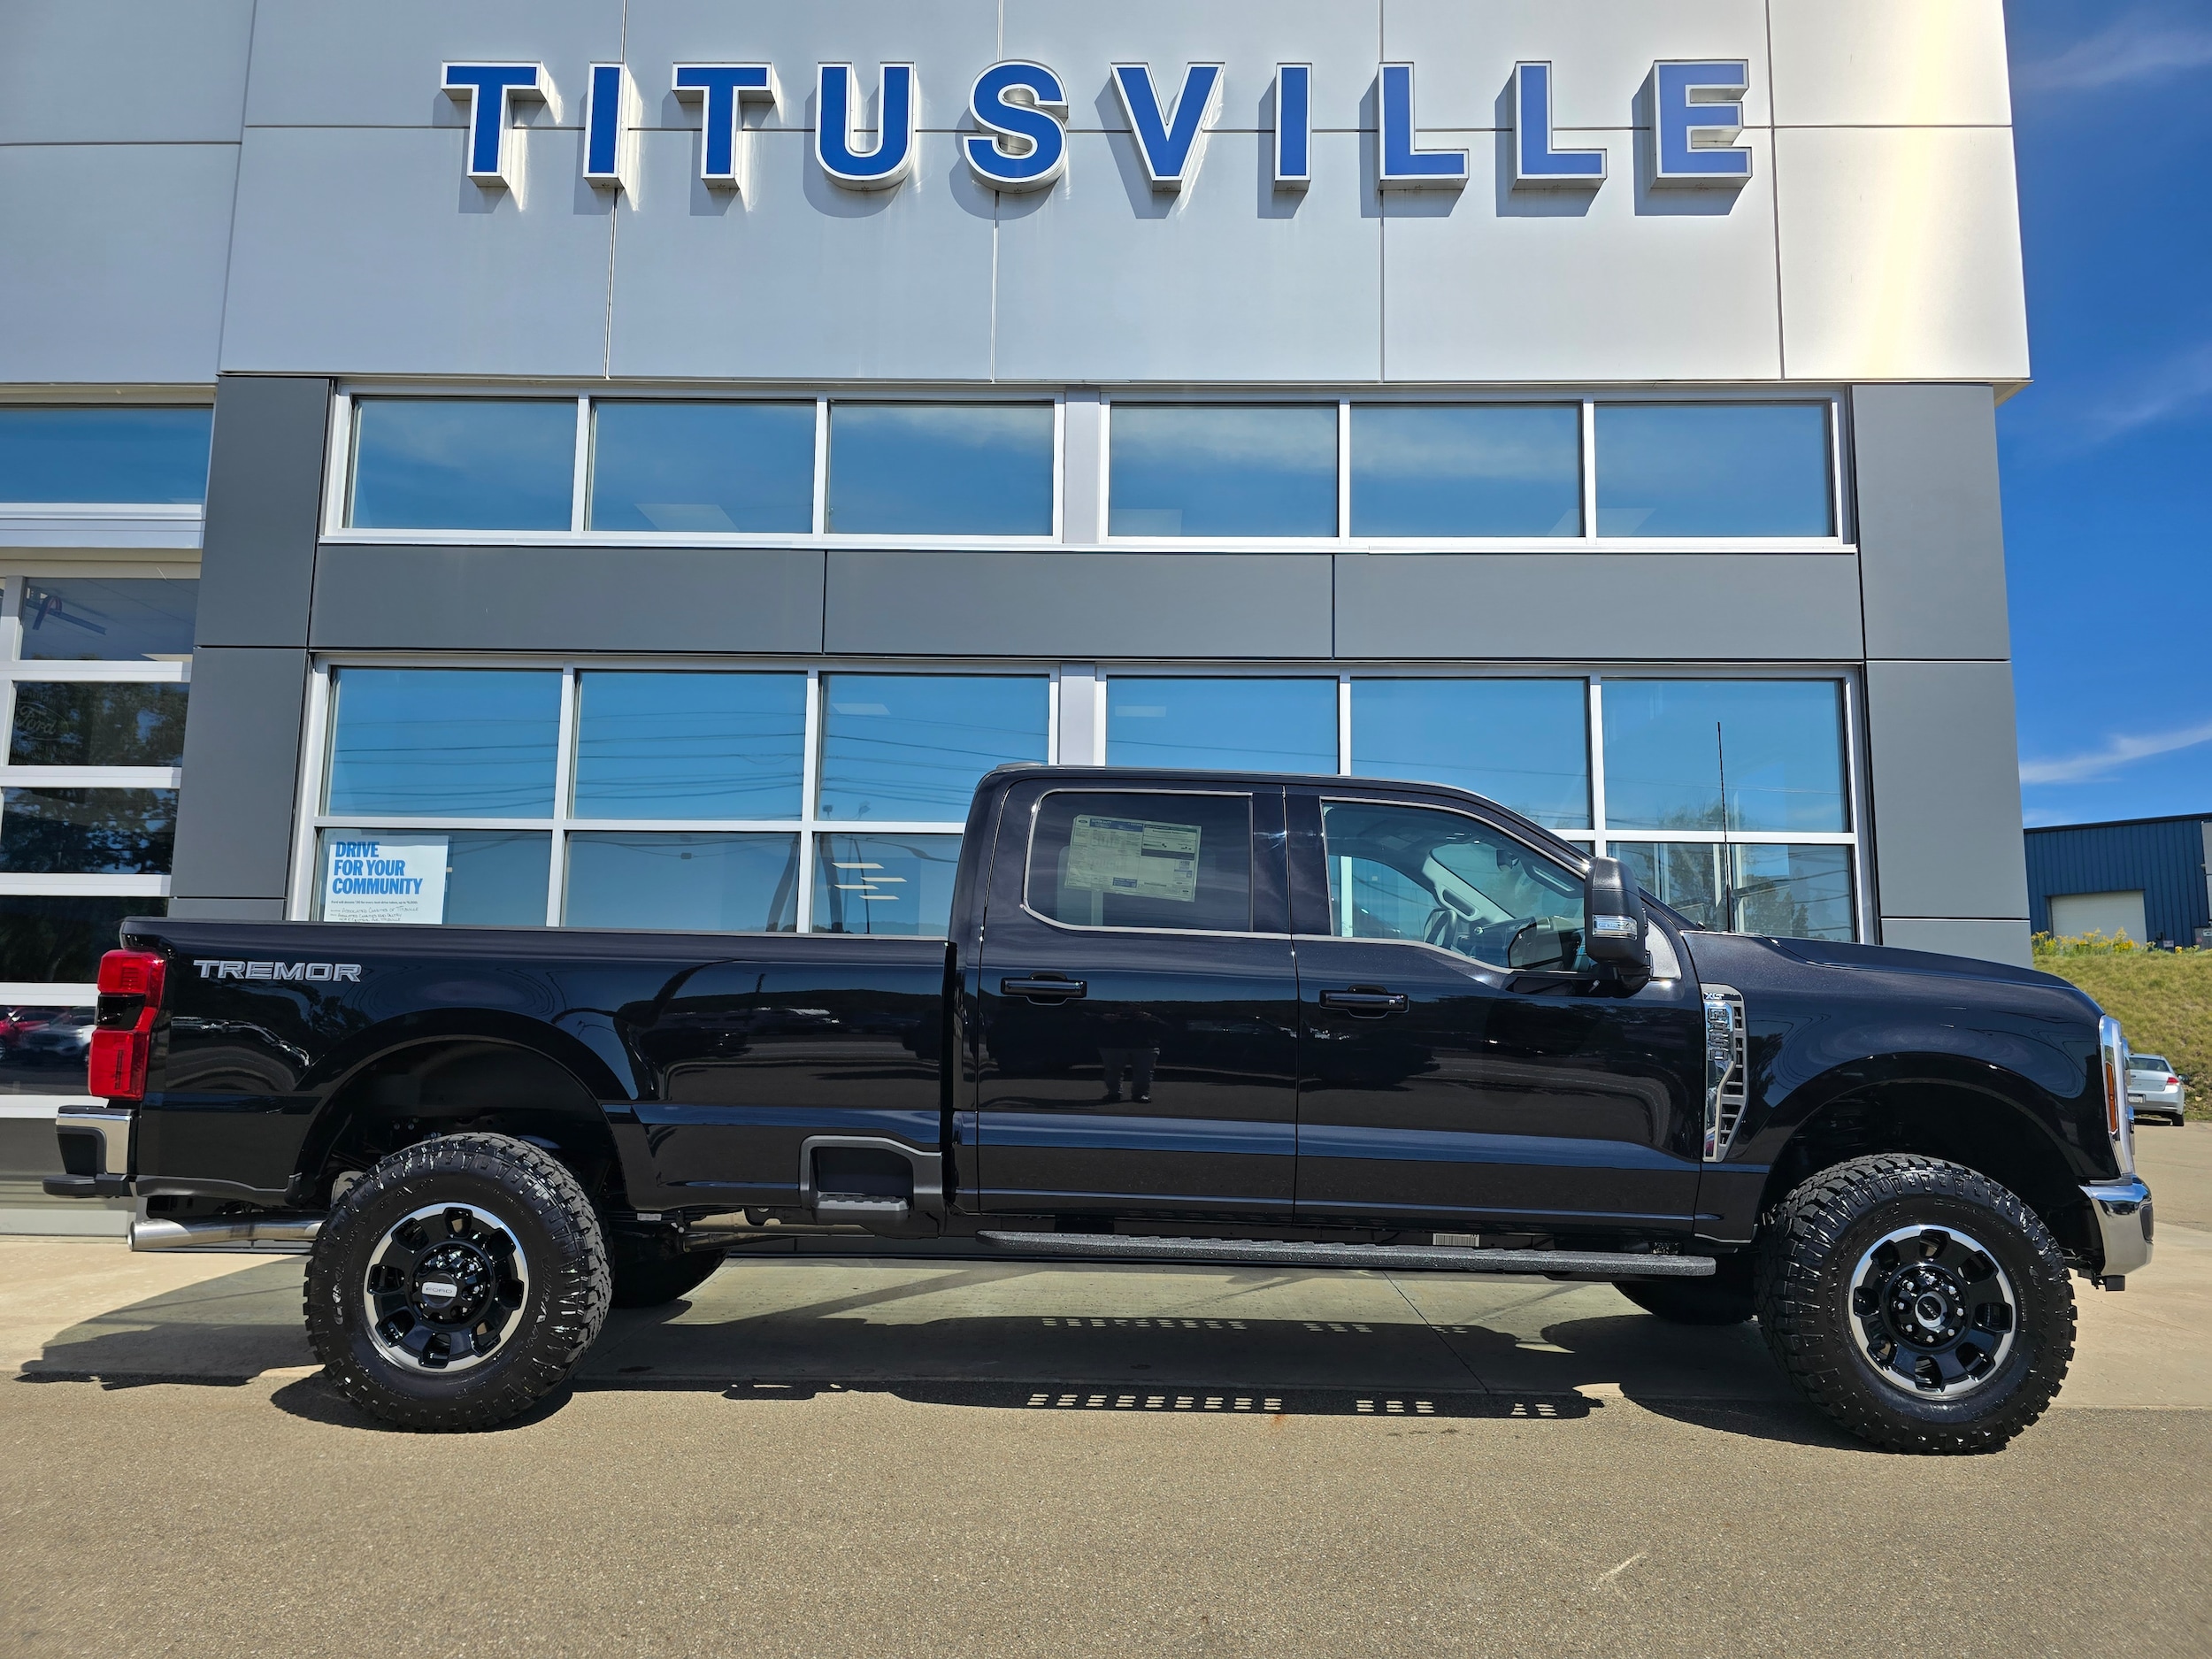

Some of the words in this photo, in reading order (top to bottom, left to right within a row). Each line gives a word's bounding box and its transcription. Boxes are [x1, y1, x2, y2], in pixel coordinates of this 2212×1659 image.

[442, 58, 1754, 187] TITUSVILLE
[335, 841, 380, 857] DRIVE
[334, 860, 363, 876] FOR
[366, 860, 405, 876] YOUR
[333, 878, 423, 895] COMMUNITY
[193, 959, 362, 982] TREMOR
